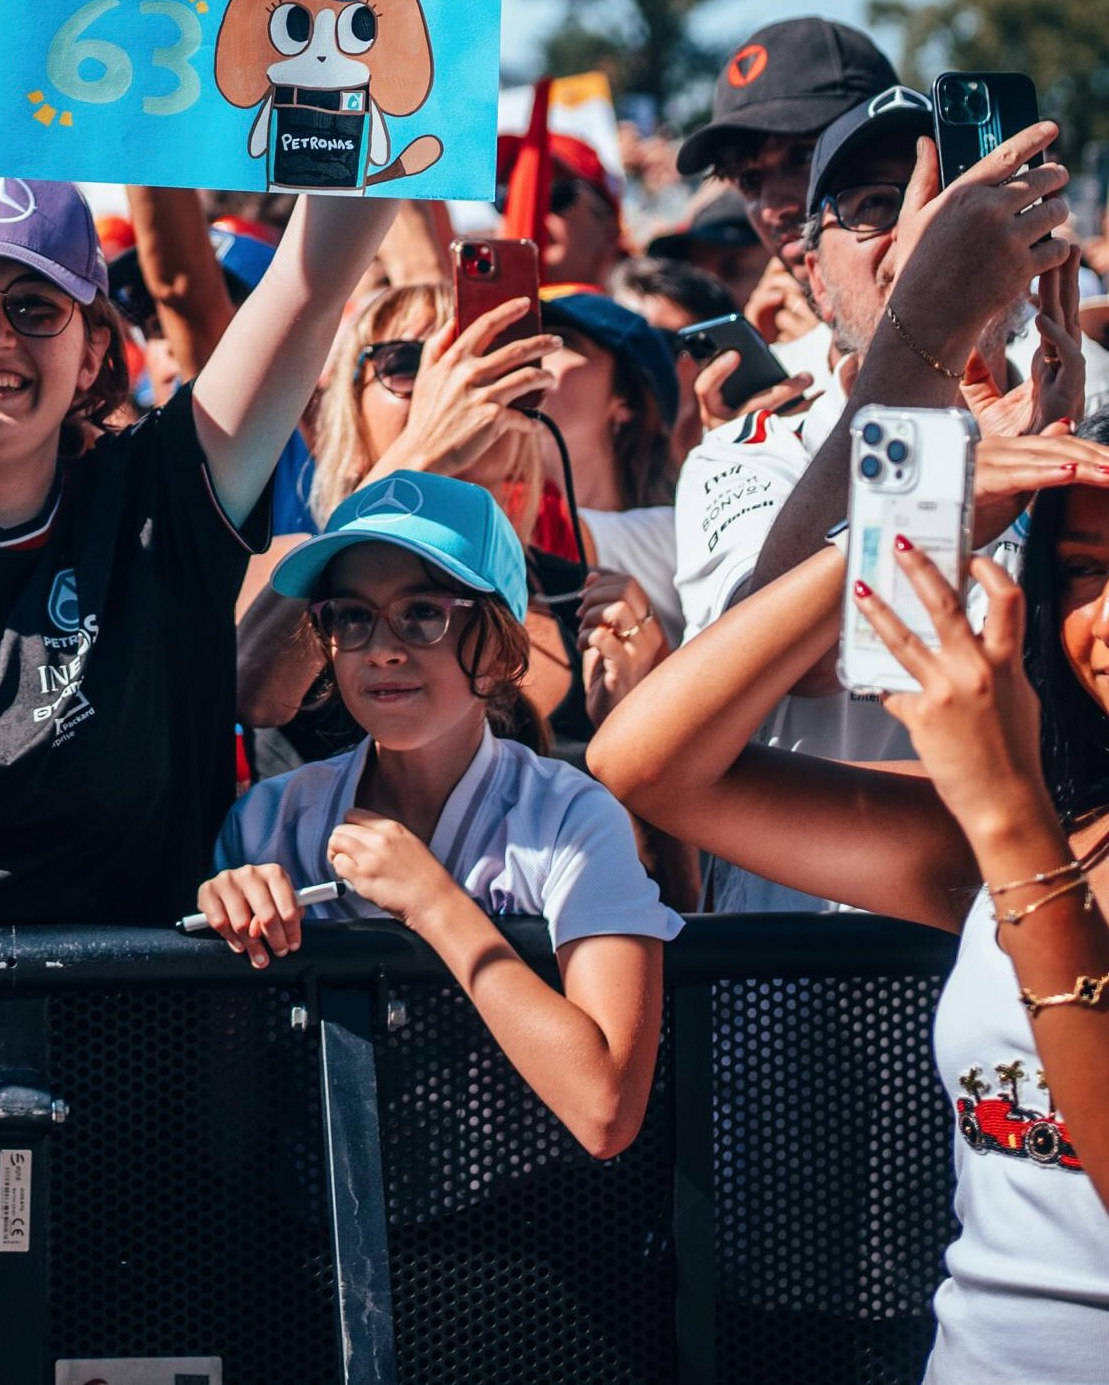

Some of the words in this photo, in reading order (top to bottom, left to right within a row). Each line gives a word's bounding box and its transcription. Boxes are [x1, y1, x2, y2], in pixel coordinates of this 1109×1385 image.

[281, 133, 354, 152] PETRONAS
[702, 481, 772, 533] BONVOY
[62, 707, 96, 731] Packard
